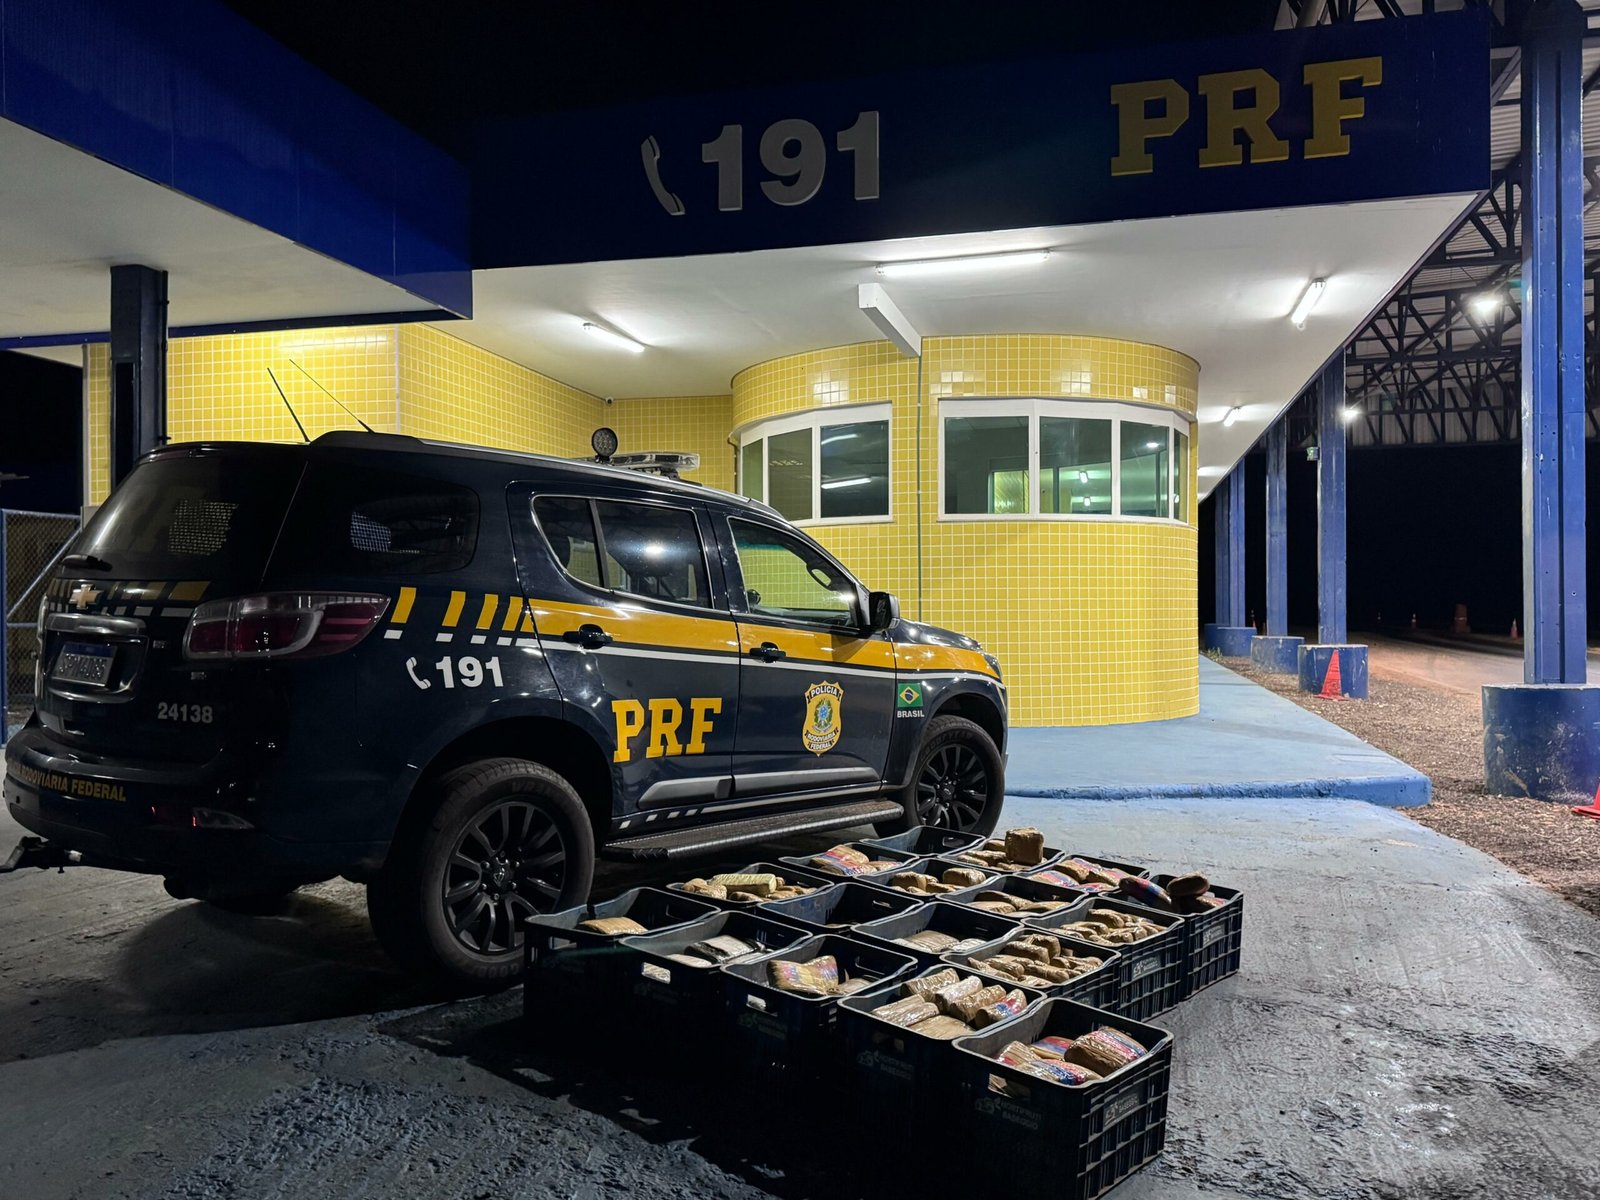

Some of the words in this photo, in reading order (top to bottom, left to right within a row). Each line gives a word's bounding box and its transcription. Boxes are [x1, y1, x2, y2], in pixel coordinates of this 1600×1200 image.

[1110, 56, 1383, 177] PRF
[701, 110, 880, 213] 191
[435, 655, 504, 690] 191
[157, 701, 214, 725] 24138
[896, 709, 925, 719] BRASIL
[611, 697, 723, 764] PRF
[810, 741, 832, 750] FEDERAL
[71, 776, 128, 802] FEDERAL
